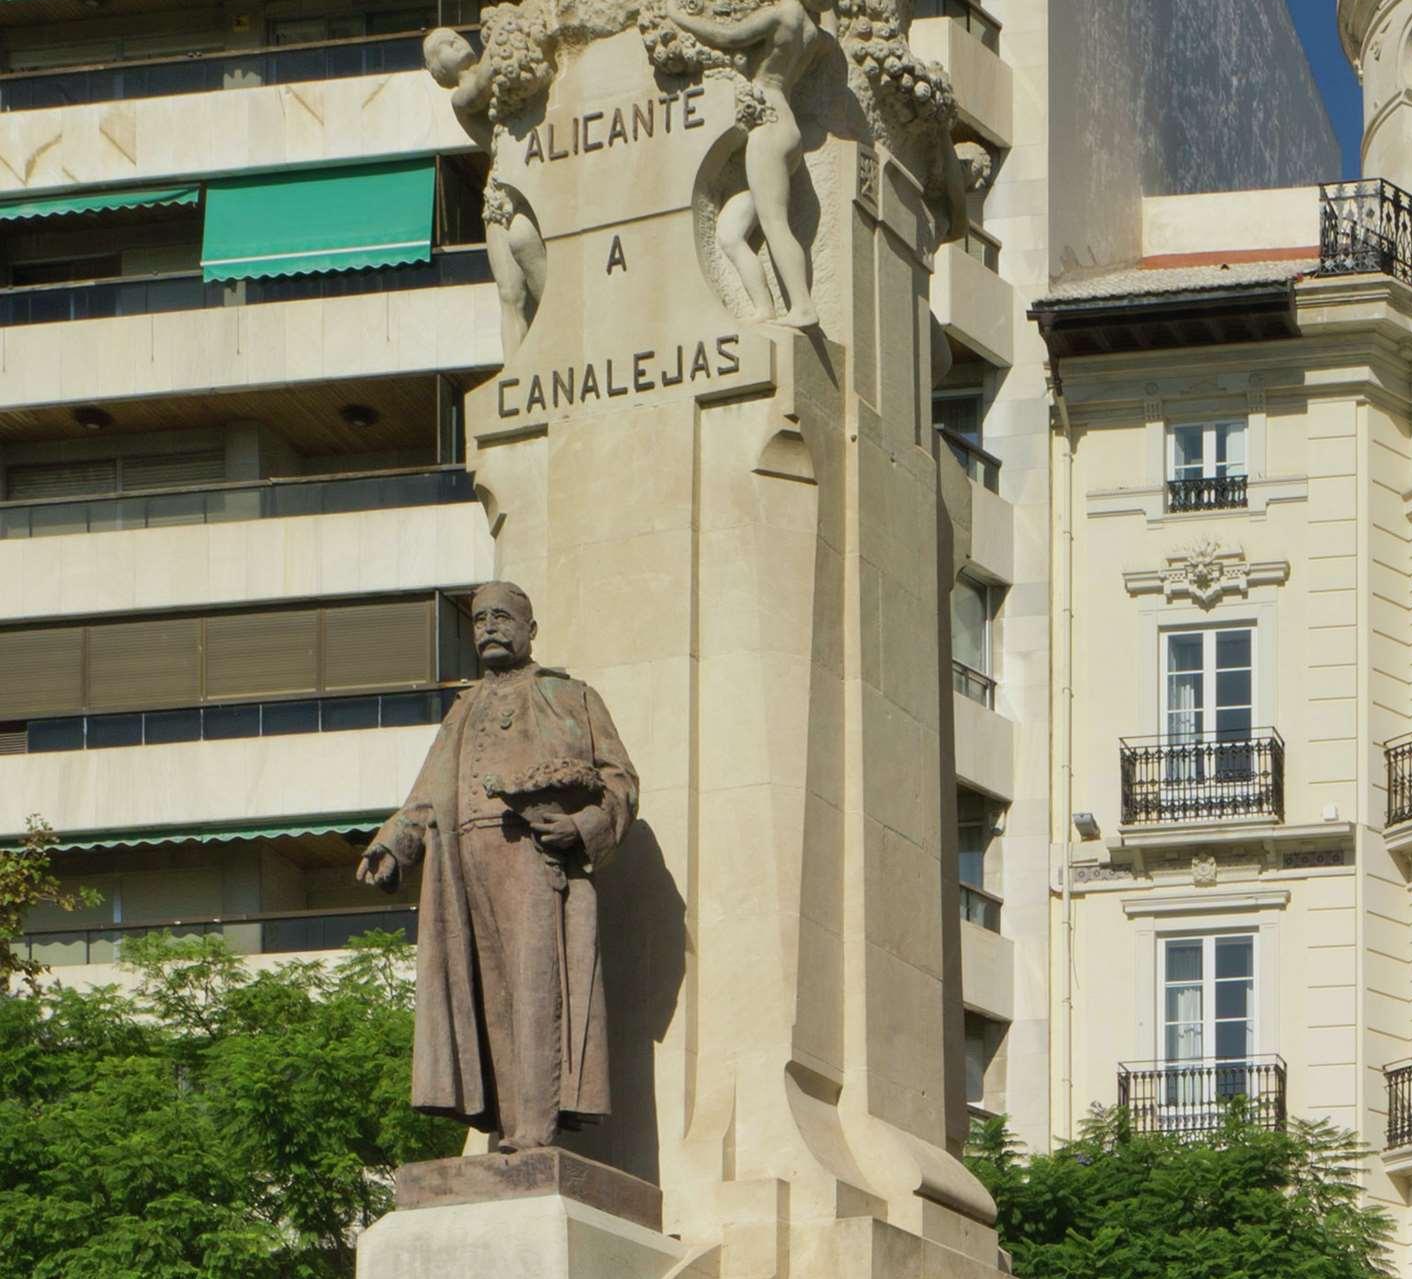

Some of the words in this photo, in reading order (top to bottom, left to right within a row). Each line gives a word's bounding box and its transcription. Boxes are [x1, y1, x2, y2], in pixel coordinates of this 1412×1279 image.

[525, 87, 705, 166] ALICANTE
[605, 235, 627, 275] A
[498, 334, 740, 418] CANALEJAS
